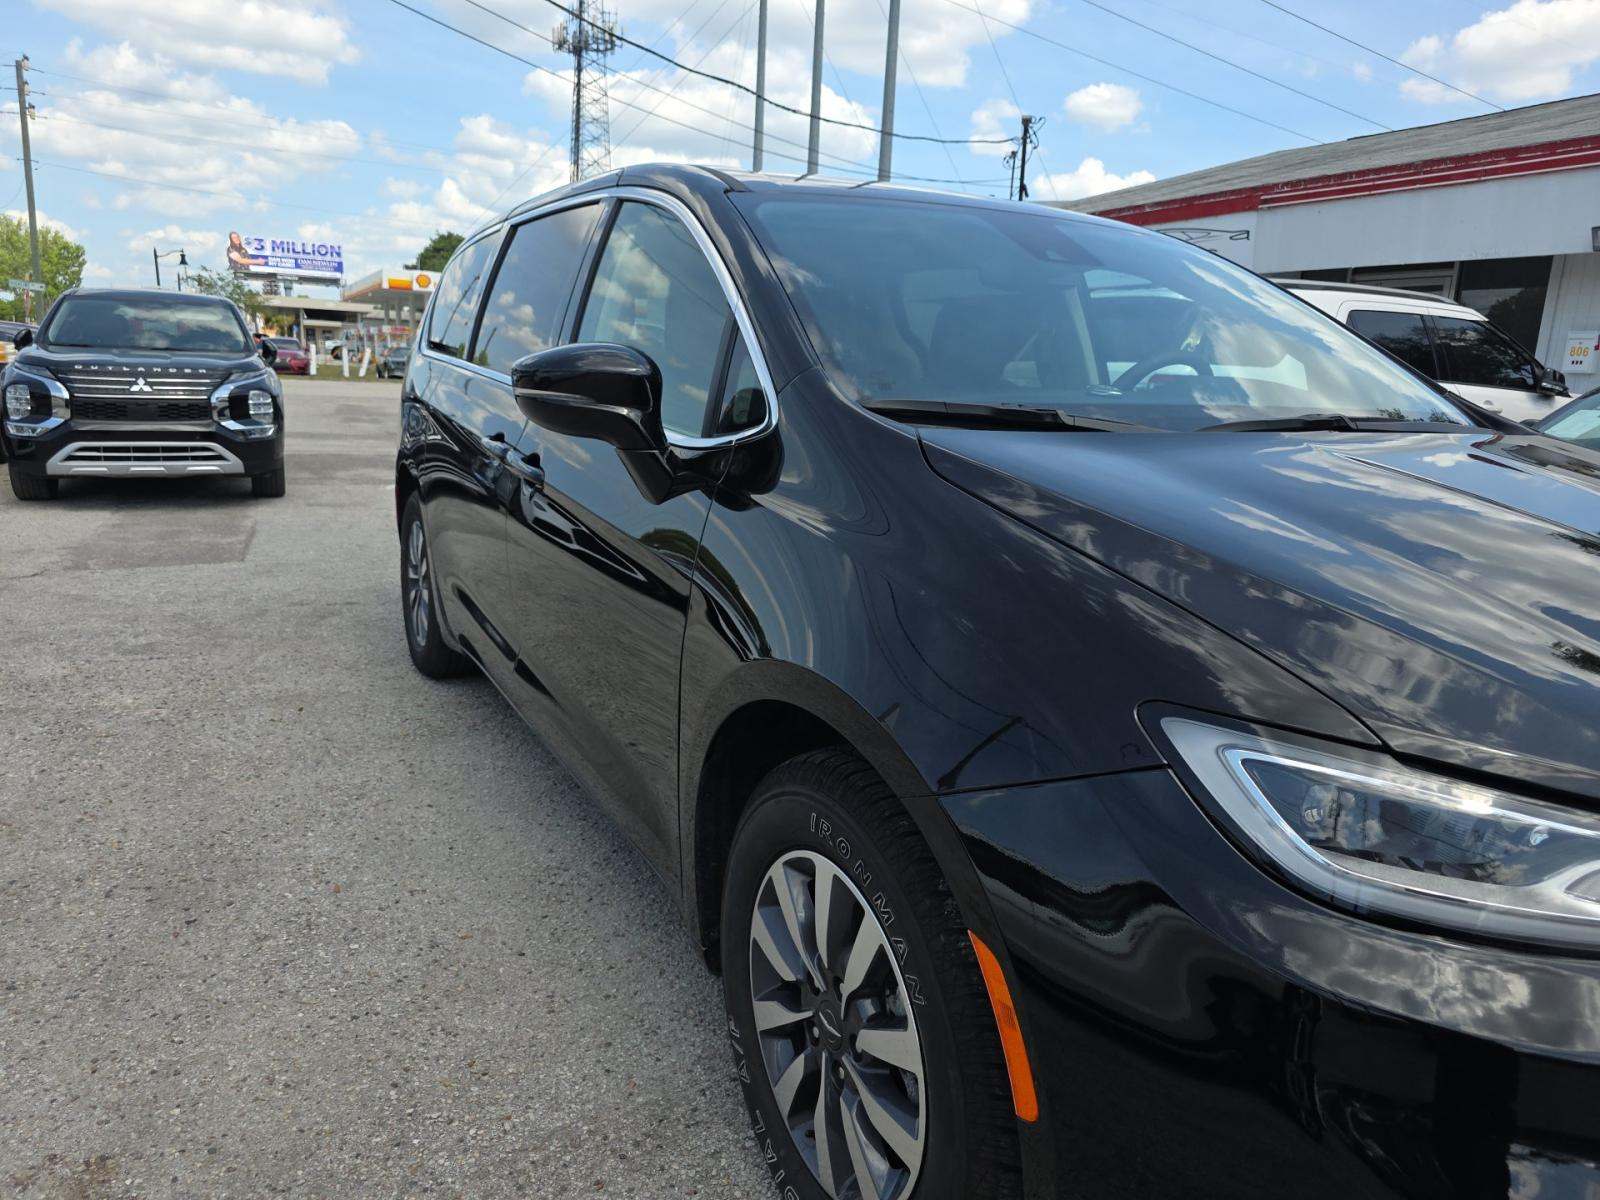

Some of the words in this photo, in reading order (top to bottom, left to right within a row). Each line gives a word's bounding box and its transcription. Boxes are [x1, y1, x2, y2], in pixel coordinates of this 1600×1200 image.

[244, 236, 265, 251] $3
[271, 239, 341, 257] MILLION
[1570, 346, 1589, 357] 806
[74, 364, 207, 374] OUTLANDER
[809, 812, 927, 1006] IRONMAN
